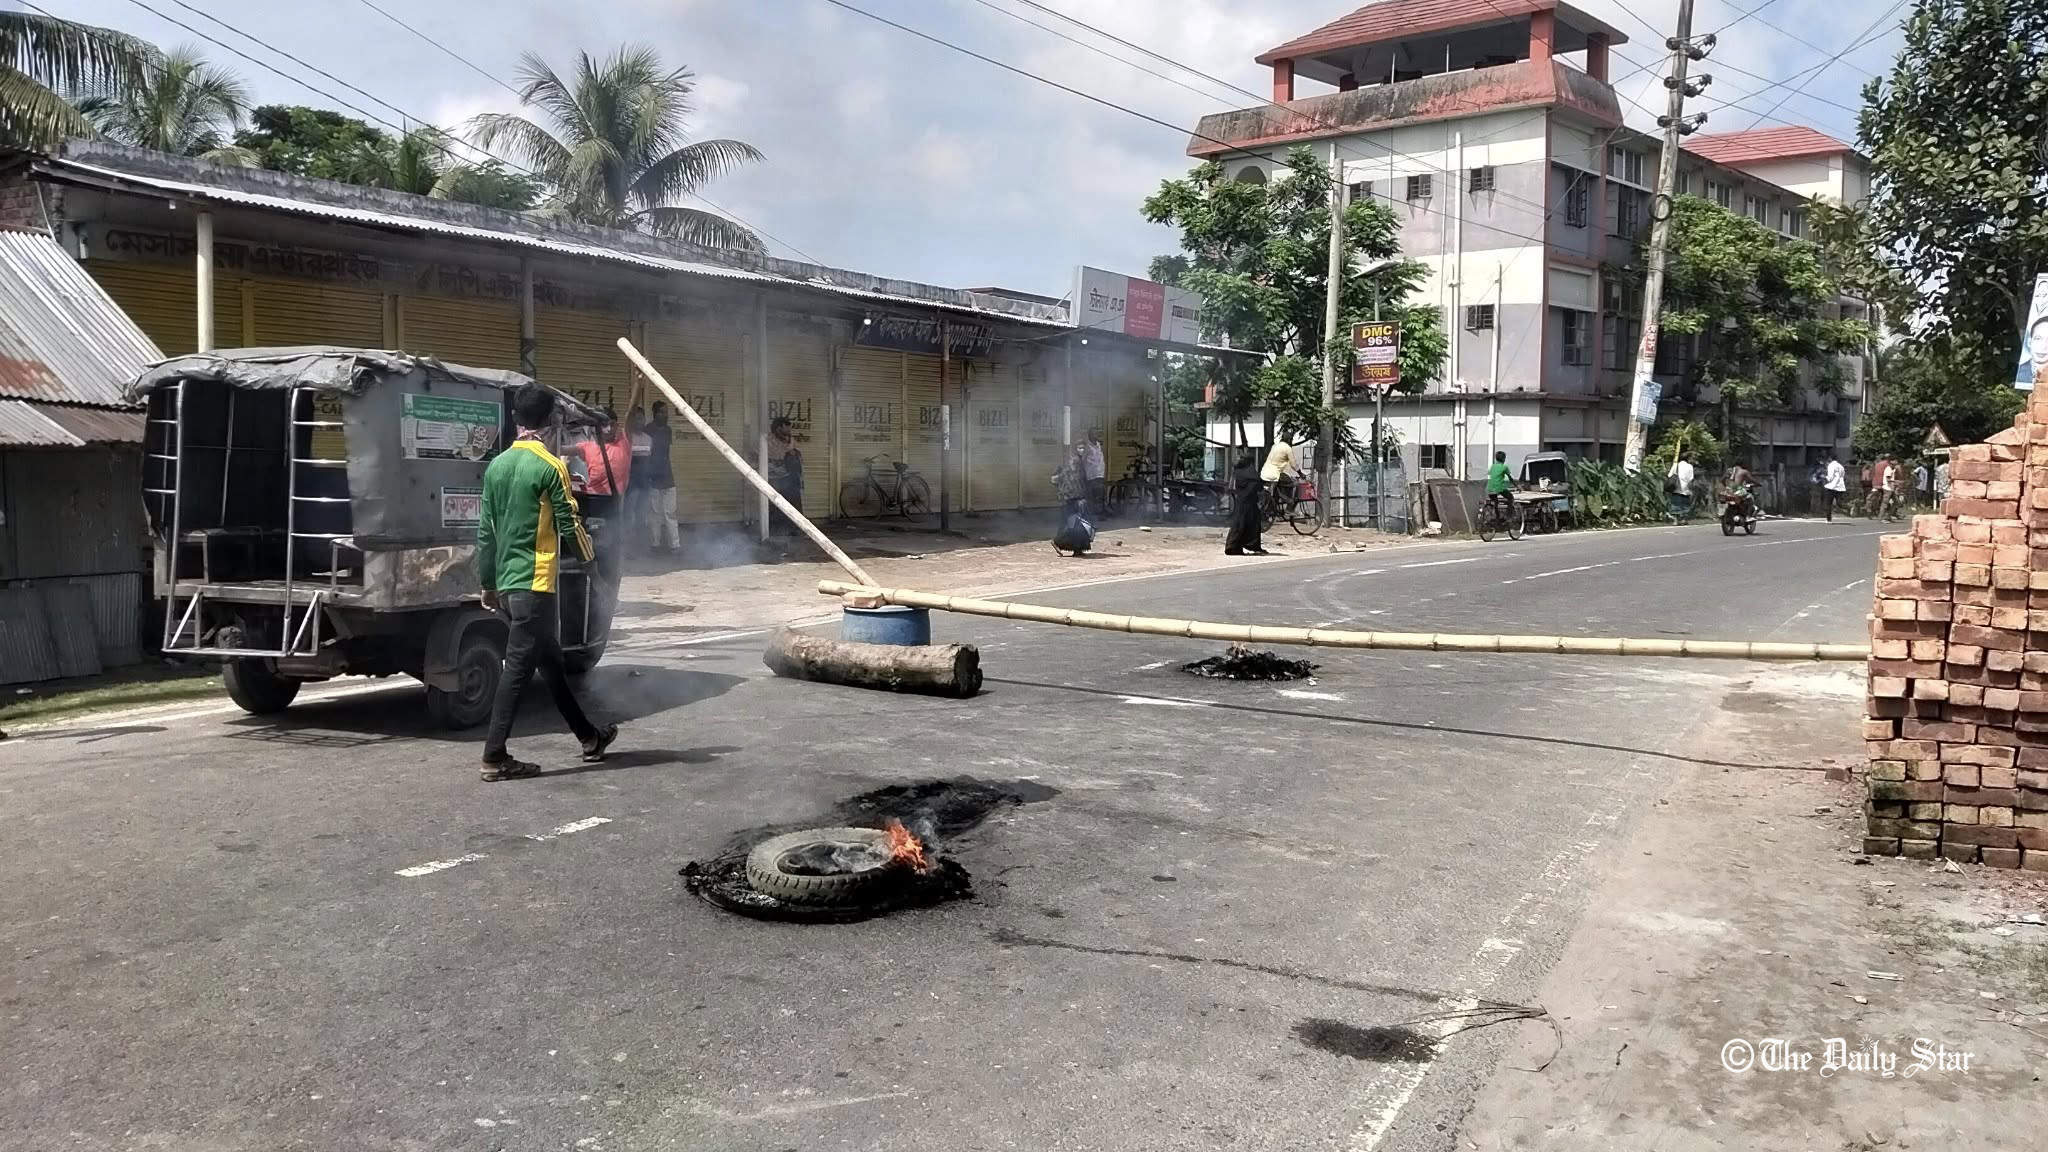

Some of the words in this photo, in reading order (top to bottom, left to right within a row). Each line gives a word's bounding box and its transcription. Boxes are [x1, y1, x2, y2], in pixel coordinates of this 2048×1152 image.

[1362, 325, 1392, 338] DMC
[1367, 336, 1392, 346] 96%
[854, 402, 892, 424] BIZLI
